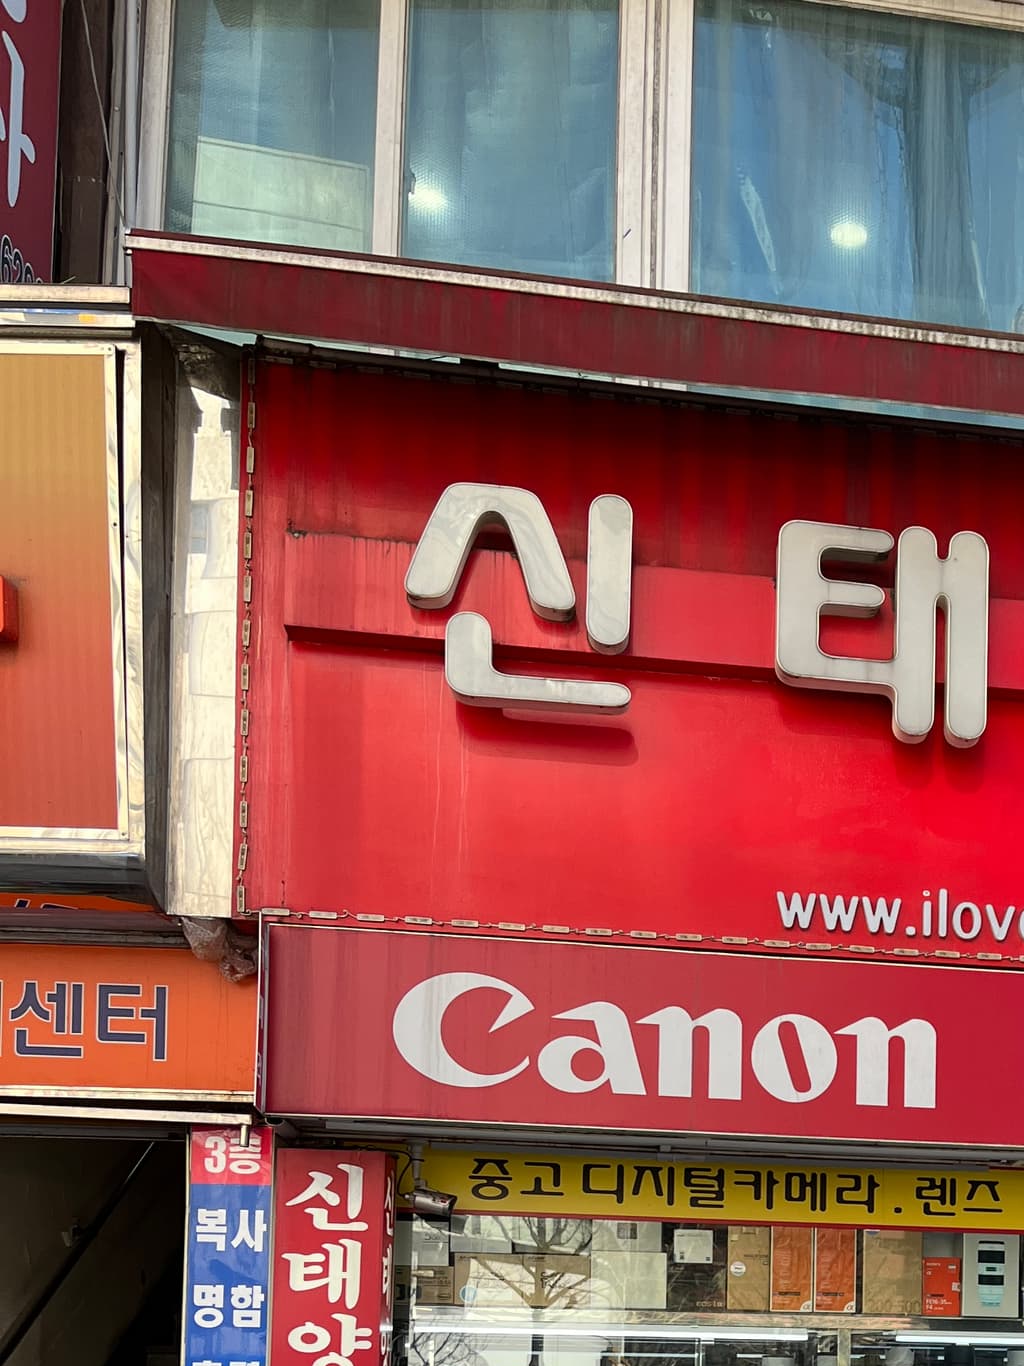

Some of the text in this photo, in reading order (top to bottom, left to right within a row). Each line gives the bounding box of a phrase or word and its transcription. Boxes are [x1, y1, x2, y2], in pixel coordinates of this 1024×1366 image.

[0, 980, 168, 1062] 센터
[392, 970, 938, 1109] Canon
[203, 1136, 262, 1175] 3층
[467, 1157, 565, 1202] 중고
[195, 1208, 268, 1253] 복사
[192, 1284, 265, 1329] 명함
